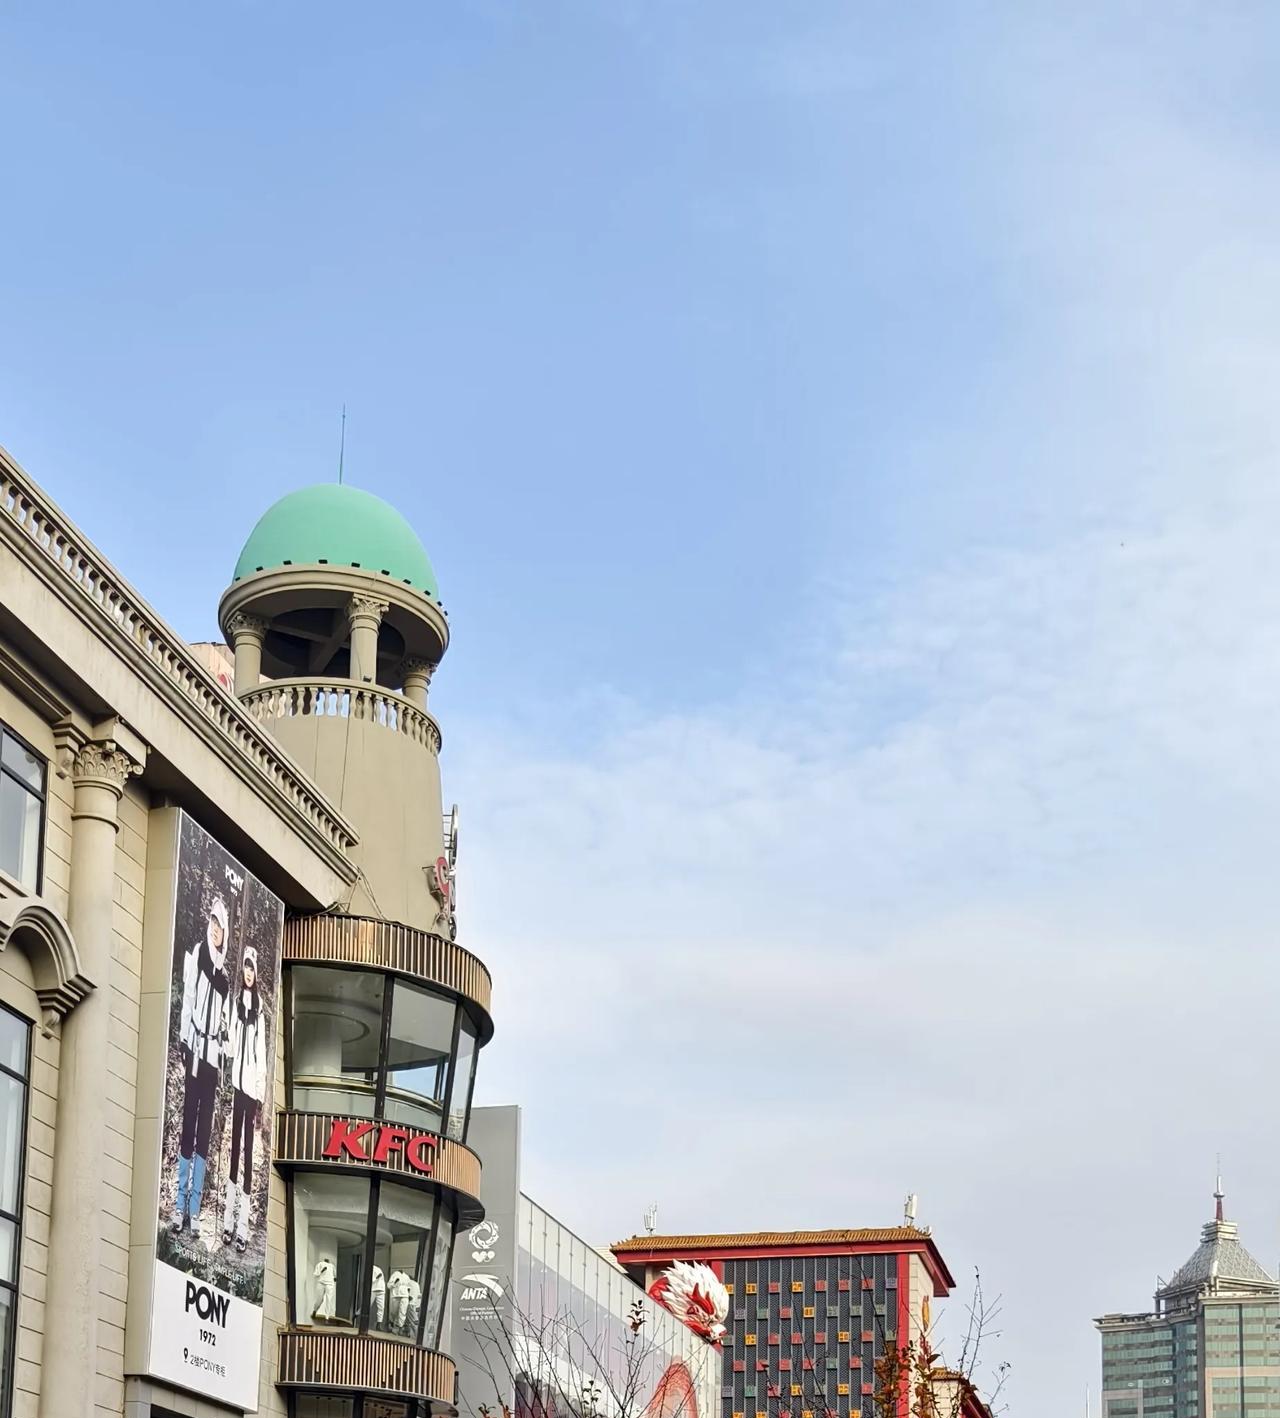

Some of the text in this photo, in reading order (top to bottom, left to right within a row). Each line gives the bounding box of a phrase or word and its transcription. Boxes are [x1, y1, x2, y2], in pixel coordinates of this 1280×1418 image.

[322, 1120, 438, 1172] KFC
[185, 1280, 230, 1328] PONY
[460, 1287, 487, 1300] ANTA
[199, 1328, 217, 1346] 1972
